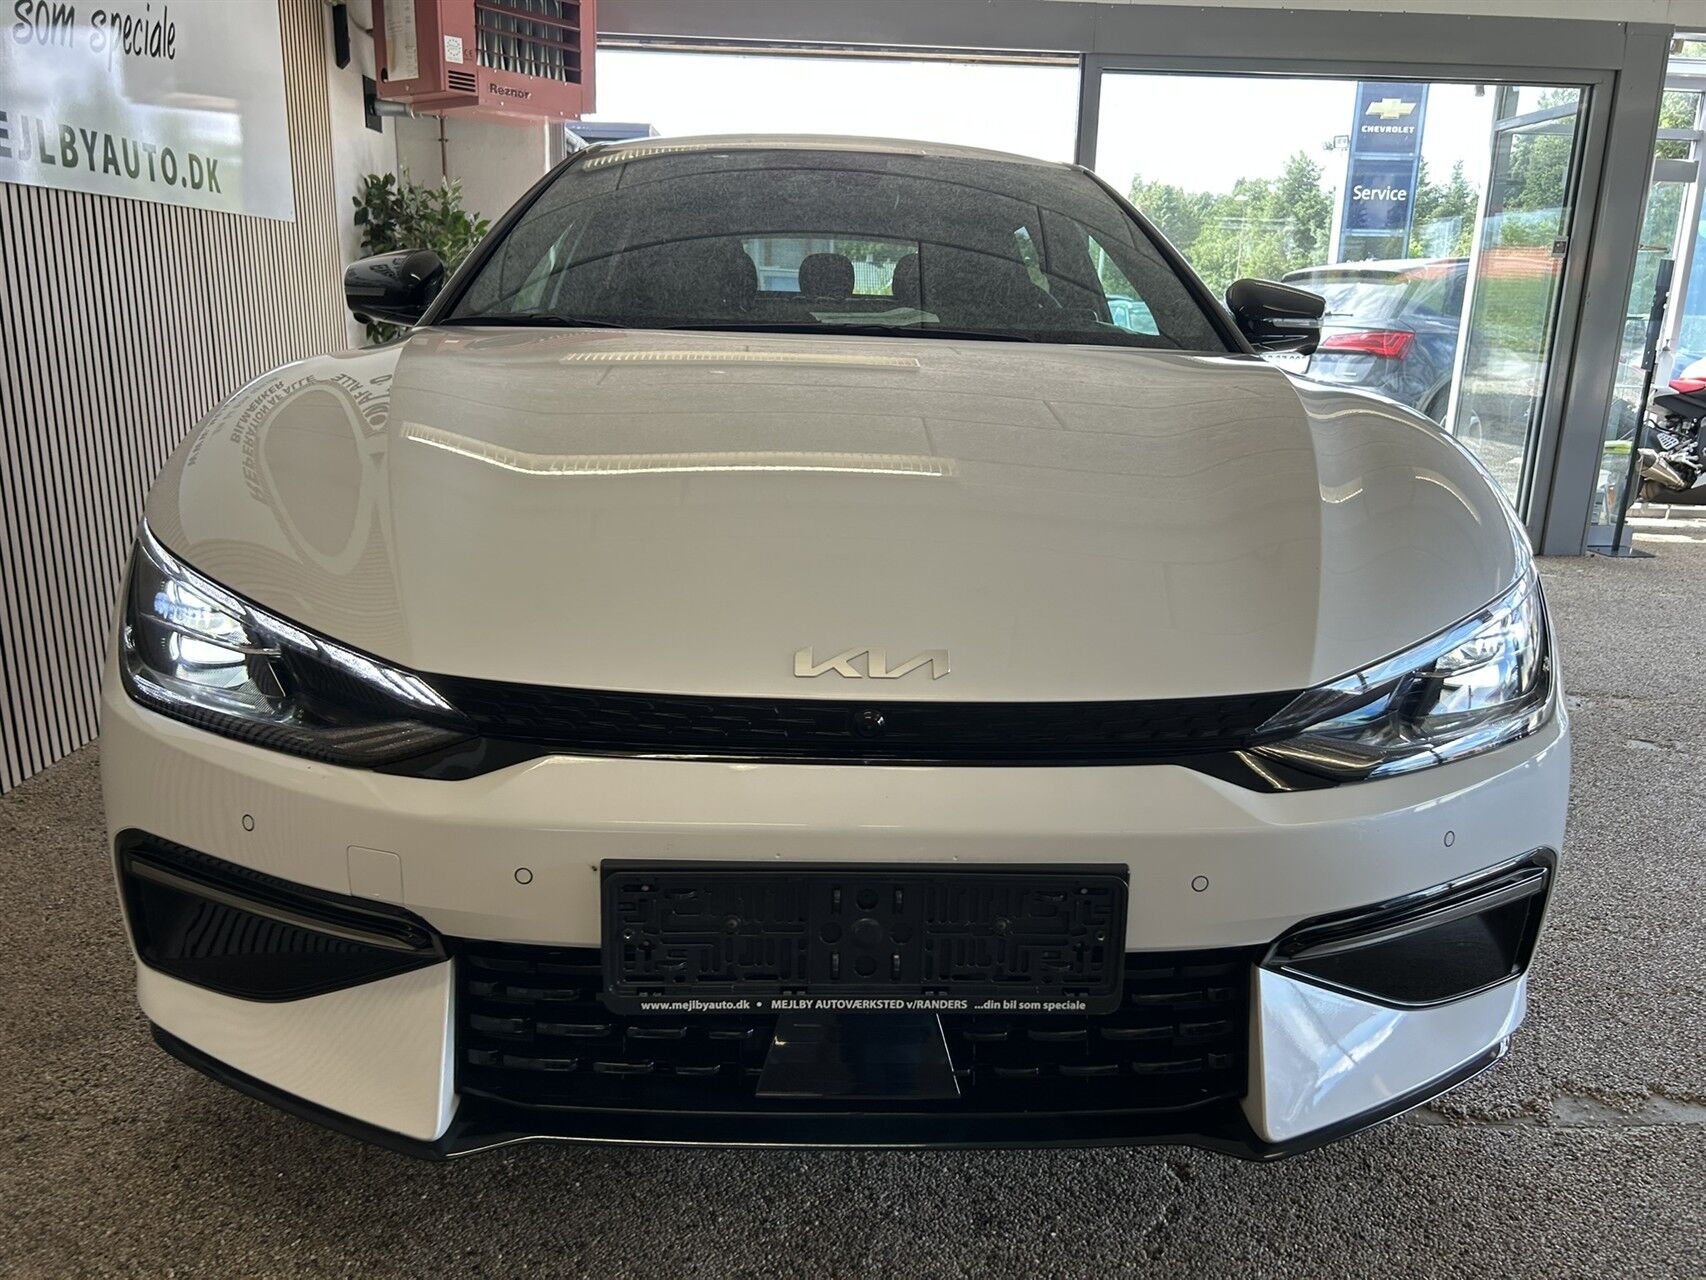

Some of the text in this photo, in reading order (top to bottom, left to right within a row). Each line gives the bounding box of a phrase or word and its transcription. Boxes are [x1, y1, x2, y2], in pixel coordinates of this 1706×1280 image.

[90, 3, 176, 72] speciale
[489, 83, 531, 99] Reznor
[1361, 125, 1415, 134] CHEVROLET
[1353, 185, 1407, 201] Service
[793, 647, 951, 680] KIA
[641, 1000, 750, 1011] www.mejlbyauto.dk
[771, 1000, 813, 1009] MEJLBY
[815, 1000, 904, 1009] AUTOVÆRKSTED
[906, 1000, 968, 1009] v/RANDERS
[1003, 1000, 1017, 1009] bil
[1018, 1002, 1041, 1010] som
[1042, 1001, 1086, 1011] speciale
